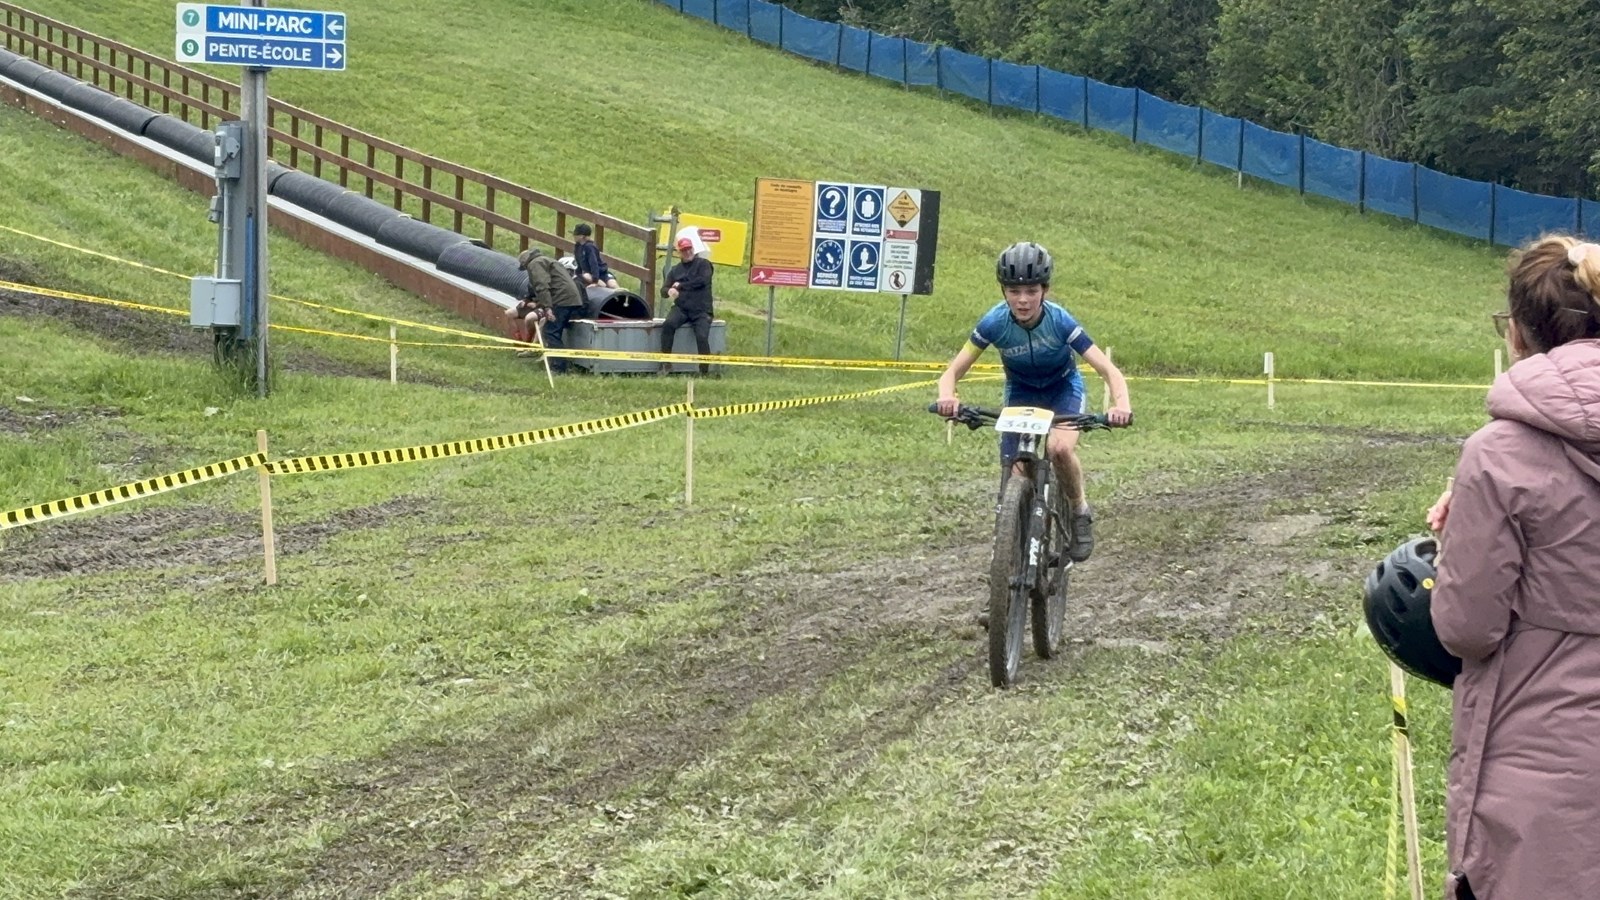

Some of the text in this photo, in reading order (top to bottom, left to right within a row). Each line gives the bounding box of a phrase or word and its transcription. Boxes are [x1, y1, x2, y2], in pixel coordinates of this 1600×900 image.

[187, 11, 313, 34] 7 MINI-PARC
[186, 42, 312, 62] 9 PENTE-ÉCOLE
[1002, 420, 1042, 431] 346
